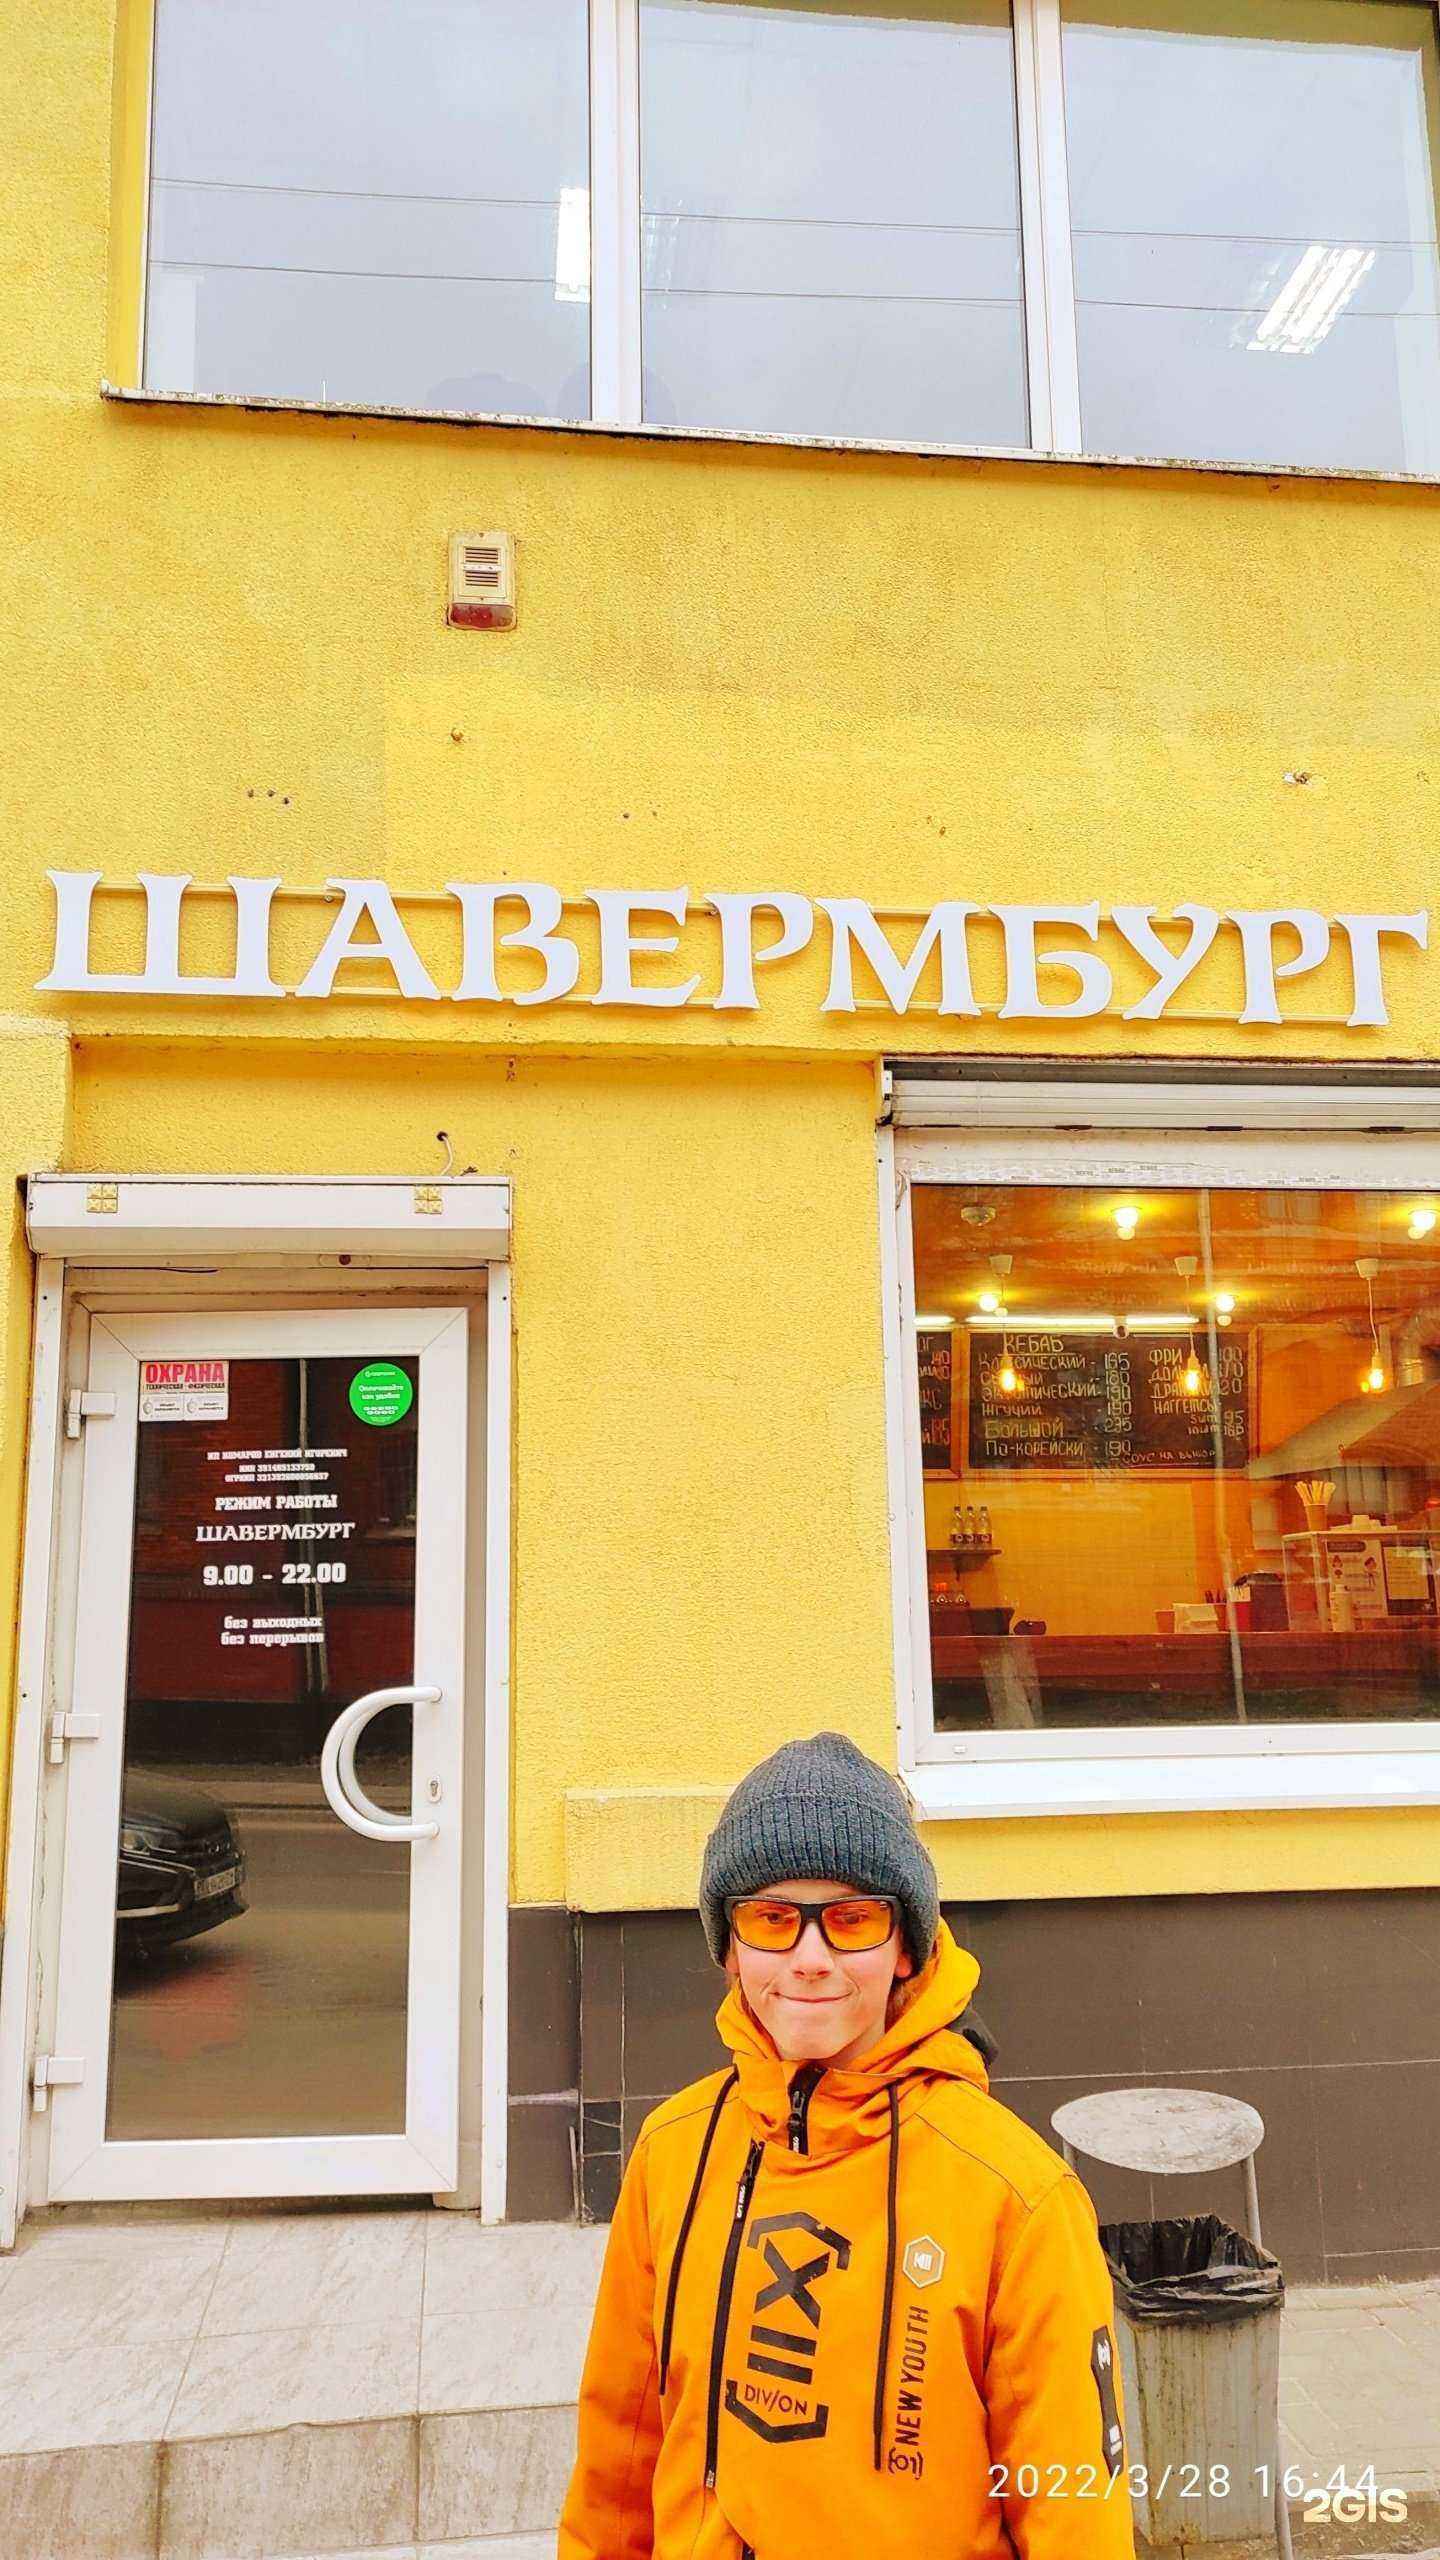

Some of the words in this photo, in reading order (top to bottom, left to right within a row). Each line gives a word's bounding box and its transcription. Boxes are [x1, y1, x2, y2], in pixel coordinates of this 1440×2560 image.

[34, 868, 1430, 1030] ШАВЕРМБУРГ
[145, 1363, 225, 1383] ОХРАНА
[215, 1496, 272, 1511] РЕЖИМ
[275, 1494, 338, 1509] РАБОТЫ
[196, 1522, 356, 1542] ШАВЕРМБУРГ
[203, 1564, 254, 1586] 9.00
[282, 1562, 347, 1585] 22.00
[223, 1615, 248, 1629] без
[252, 1616, 323, 1629] выходных
[220, 1632, 246, 1645] без
[900, 2305, 929, 2384] YOUTH
[894, 2389, 923, 2447] NEW
